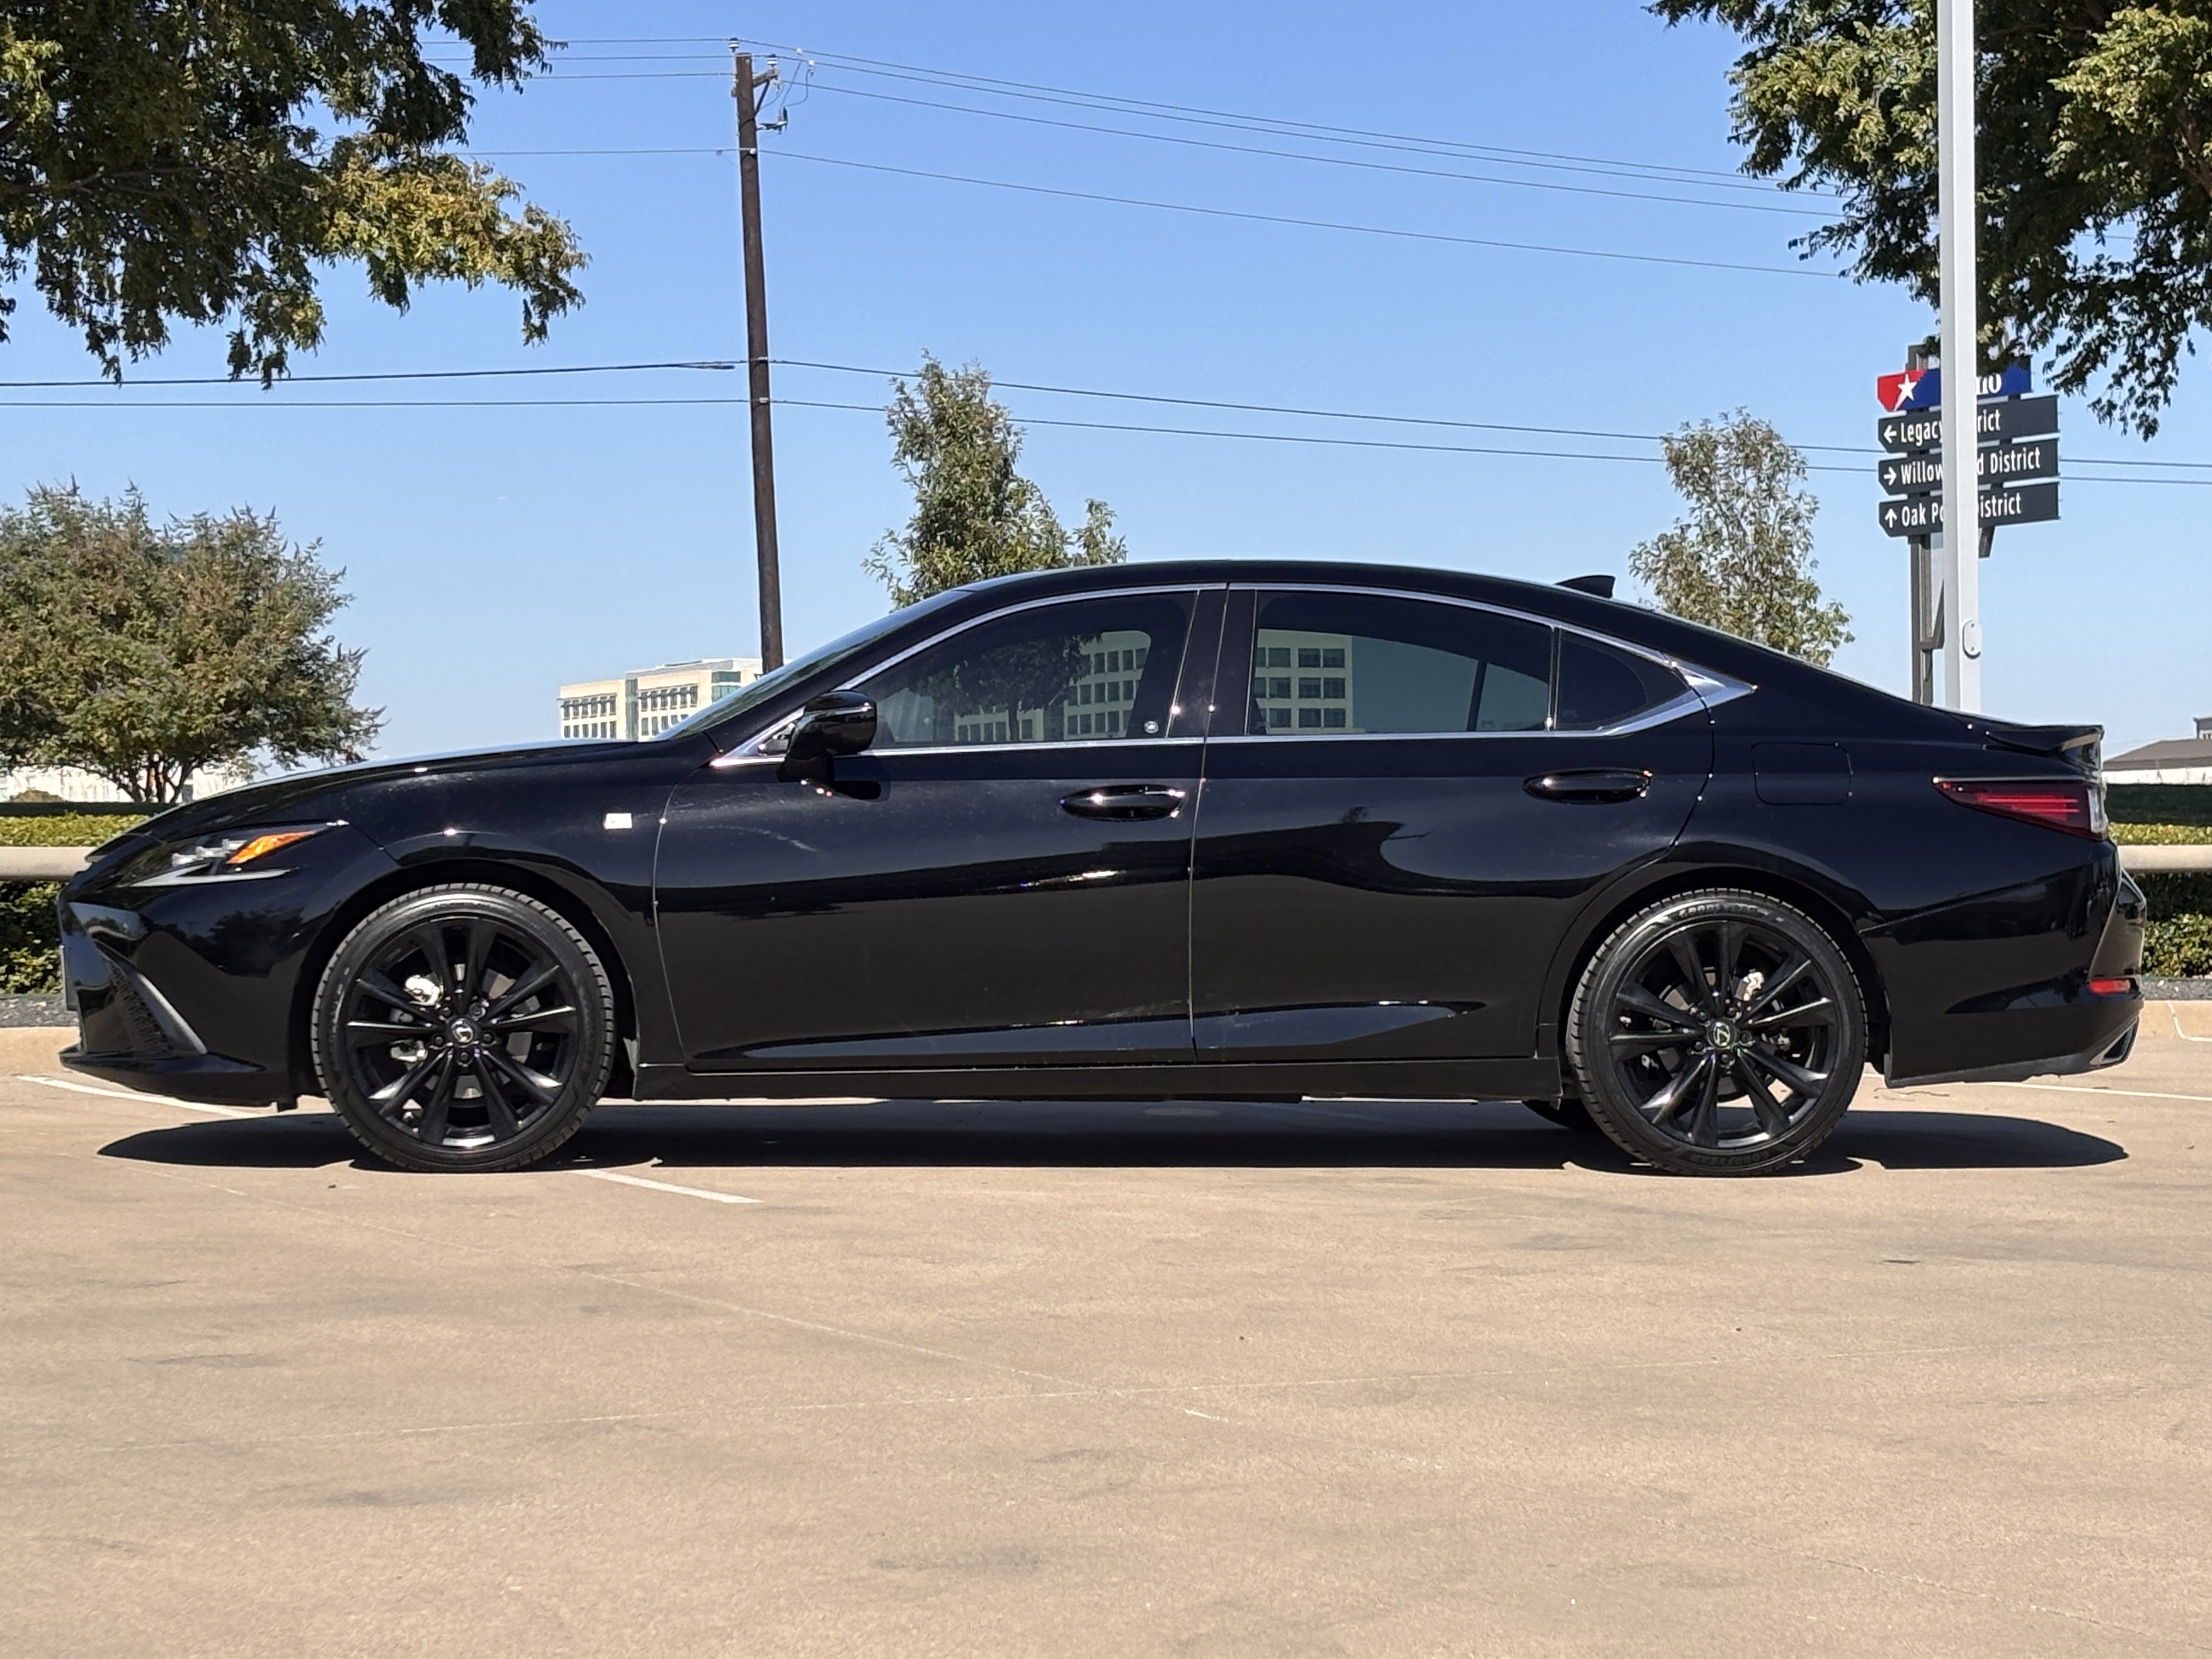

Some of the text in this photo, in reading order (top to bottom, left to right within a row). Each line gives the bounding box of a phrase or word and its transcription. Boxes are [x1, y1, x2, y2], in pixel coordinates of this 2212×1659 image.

[1977, 409, 2001, 434] rict
[1990, 447, 2040, 474] District
[1901, 503, 1926, 527] Oak
[1977, 492, 2021, 518] istrict
